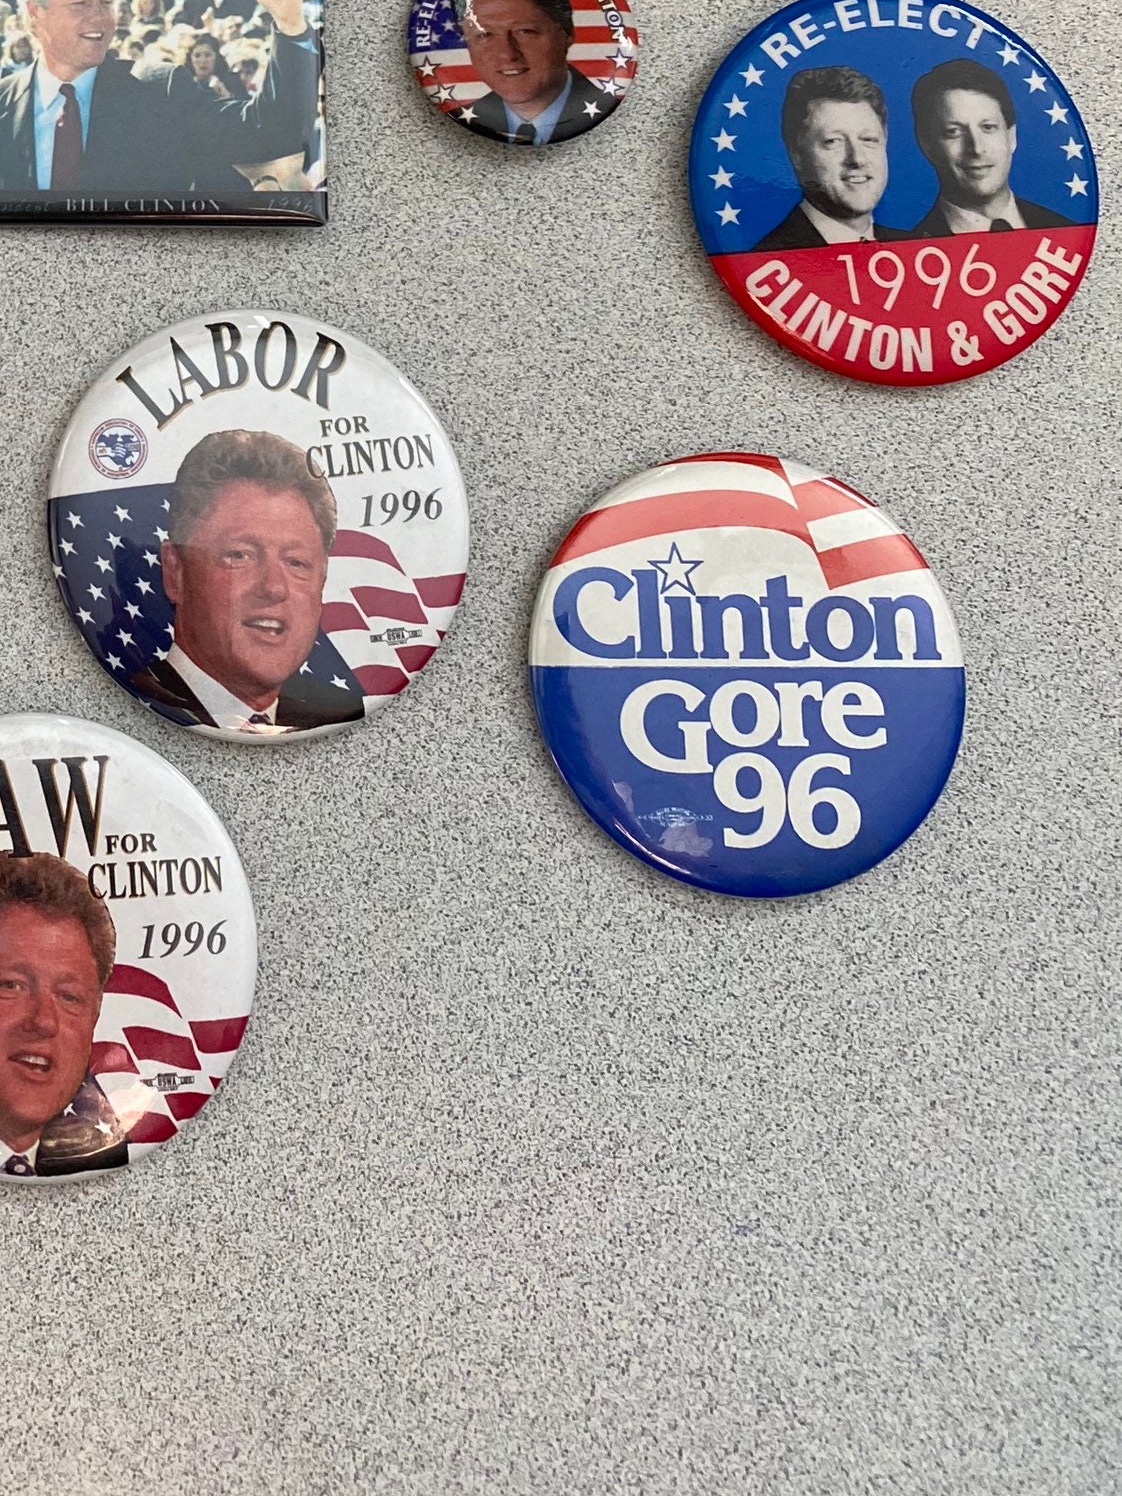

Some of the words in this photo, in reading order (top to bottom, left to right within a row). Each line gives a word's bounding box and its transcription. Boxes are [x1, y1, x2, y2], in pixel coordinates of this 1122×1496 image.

[65, 198, 115, 212] BILL
[124, 198, 222, 212] CLINTON
[836, 243, 997, 311] 1996
[745, 259, 934, 373] CLINTON
[947, 320, 985, 367] &
[983, 237, 1084, 346] GORE
[116, 321, 347, 431] LABOR
[320, 415, 370, 437] FOR
[306, 433, 436, 480] CLINTON
[360, 488, 444, 528] 1996
[552, 565, 943, 663] Clinton
[619, 679, 888, 774] Gore
[713, 752, 862, 850] 96
[105, 833, 158, 856] FOR
[88, 856, 224, 901] CLINTON
[137, 920, 228, 960] 1996
